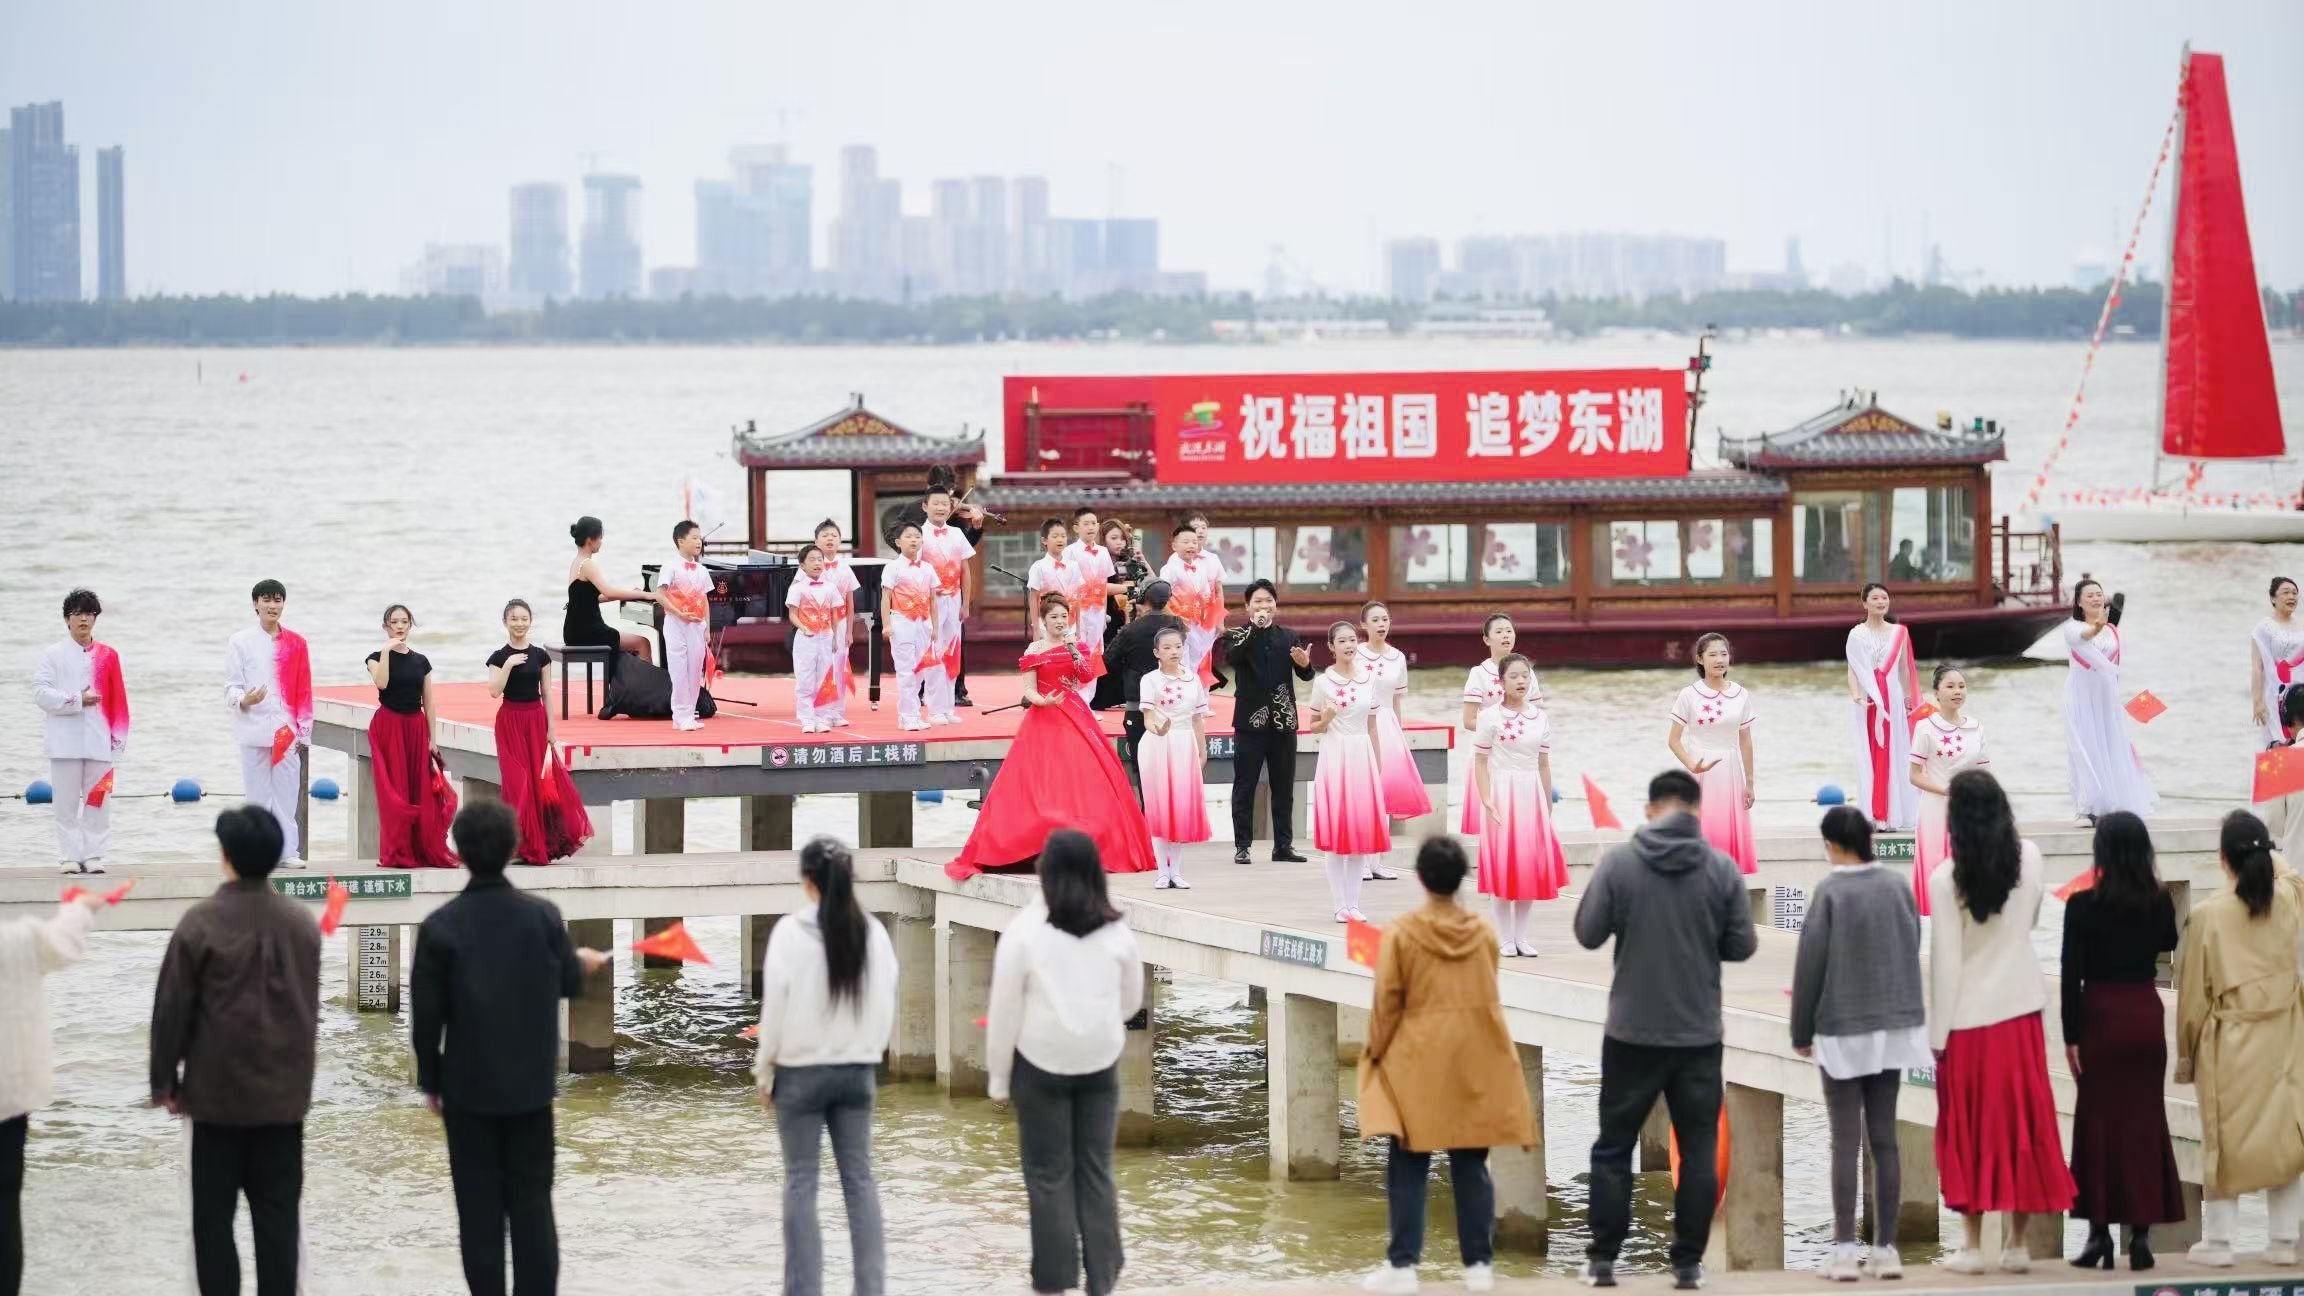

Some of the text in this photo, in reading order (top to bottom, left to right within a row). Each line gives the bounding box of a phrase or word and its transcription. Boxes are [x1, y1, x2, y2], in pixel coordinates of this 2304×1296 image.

[1239, 388, 1662, 459] 祝福祖国 追梦东湖
[794, 744, 918, 765] 请勿酒后上栈桥
[285, 879, 406, 895] 跳台水下暗礁 谨慎下水
[1786, 888, 1803, 898] 2.4m
[1786, 903, 1803, 913] 2.3m
[369, 928, 387, 937] 2.9m
[369, 942, 387, 951] 2.8m
[1271, 936, 1323, 964] 严禁在栈桥上跳水
[369, 956, 387, 965] 2.7m
[369, 970, 387, 979] 2.6m
